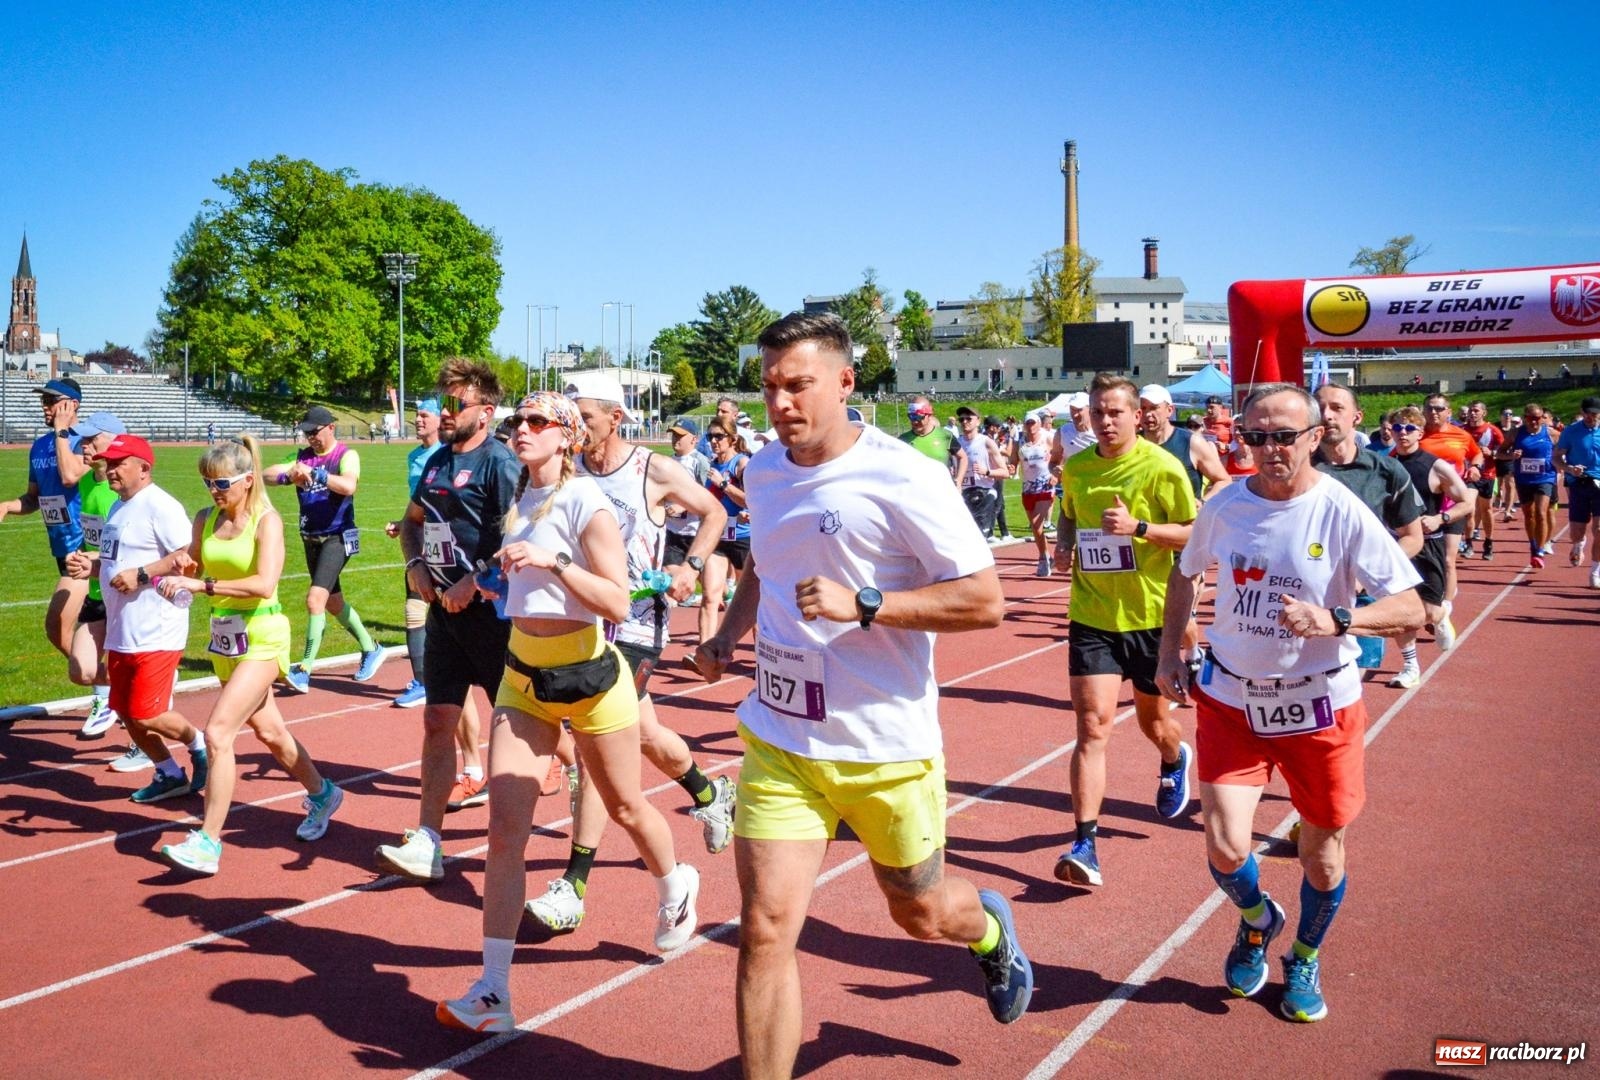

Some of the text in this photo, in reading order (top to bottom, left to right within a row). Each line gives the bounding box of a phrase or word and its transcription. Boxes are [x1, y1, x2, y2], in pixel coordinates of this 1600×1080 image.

[1427, 279, 1483, 292] BIEG
[1387, 296, 1525, 315] BEZ GRANIC
[1399, 316, 1514, 335] RACIBÓRZ
[1087, 547, 1112, 565] 116
[1269, 576, 1303, 590] BIEG
[1233, 587, 1261, 618] XII
[1238, 622, 1243, 632] 3
[1247, 623, 1275, 638] MAJA
[764, 669, 796, 704] 157
[1257, 703, 1306, 728] 149
